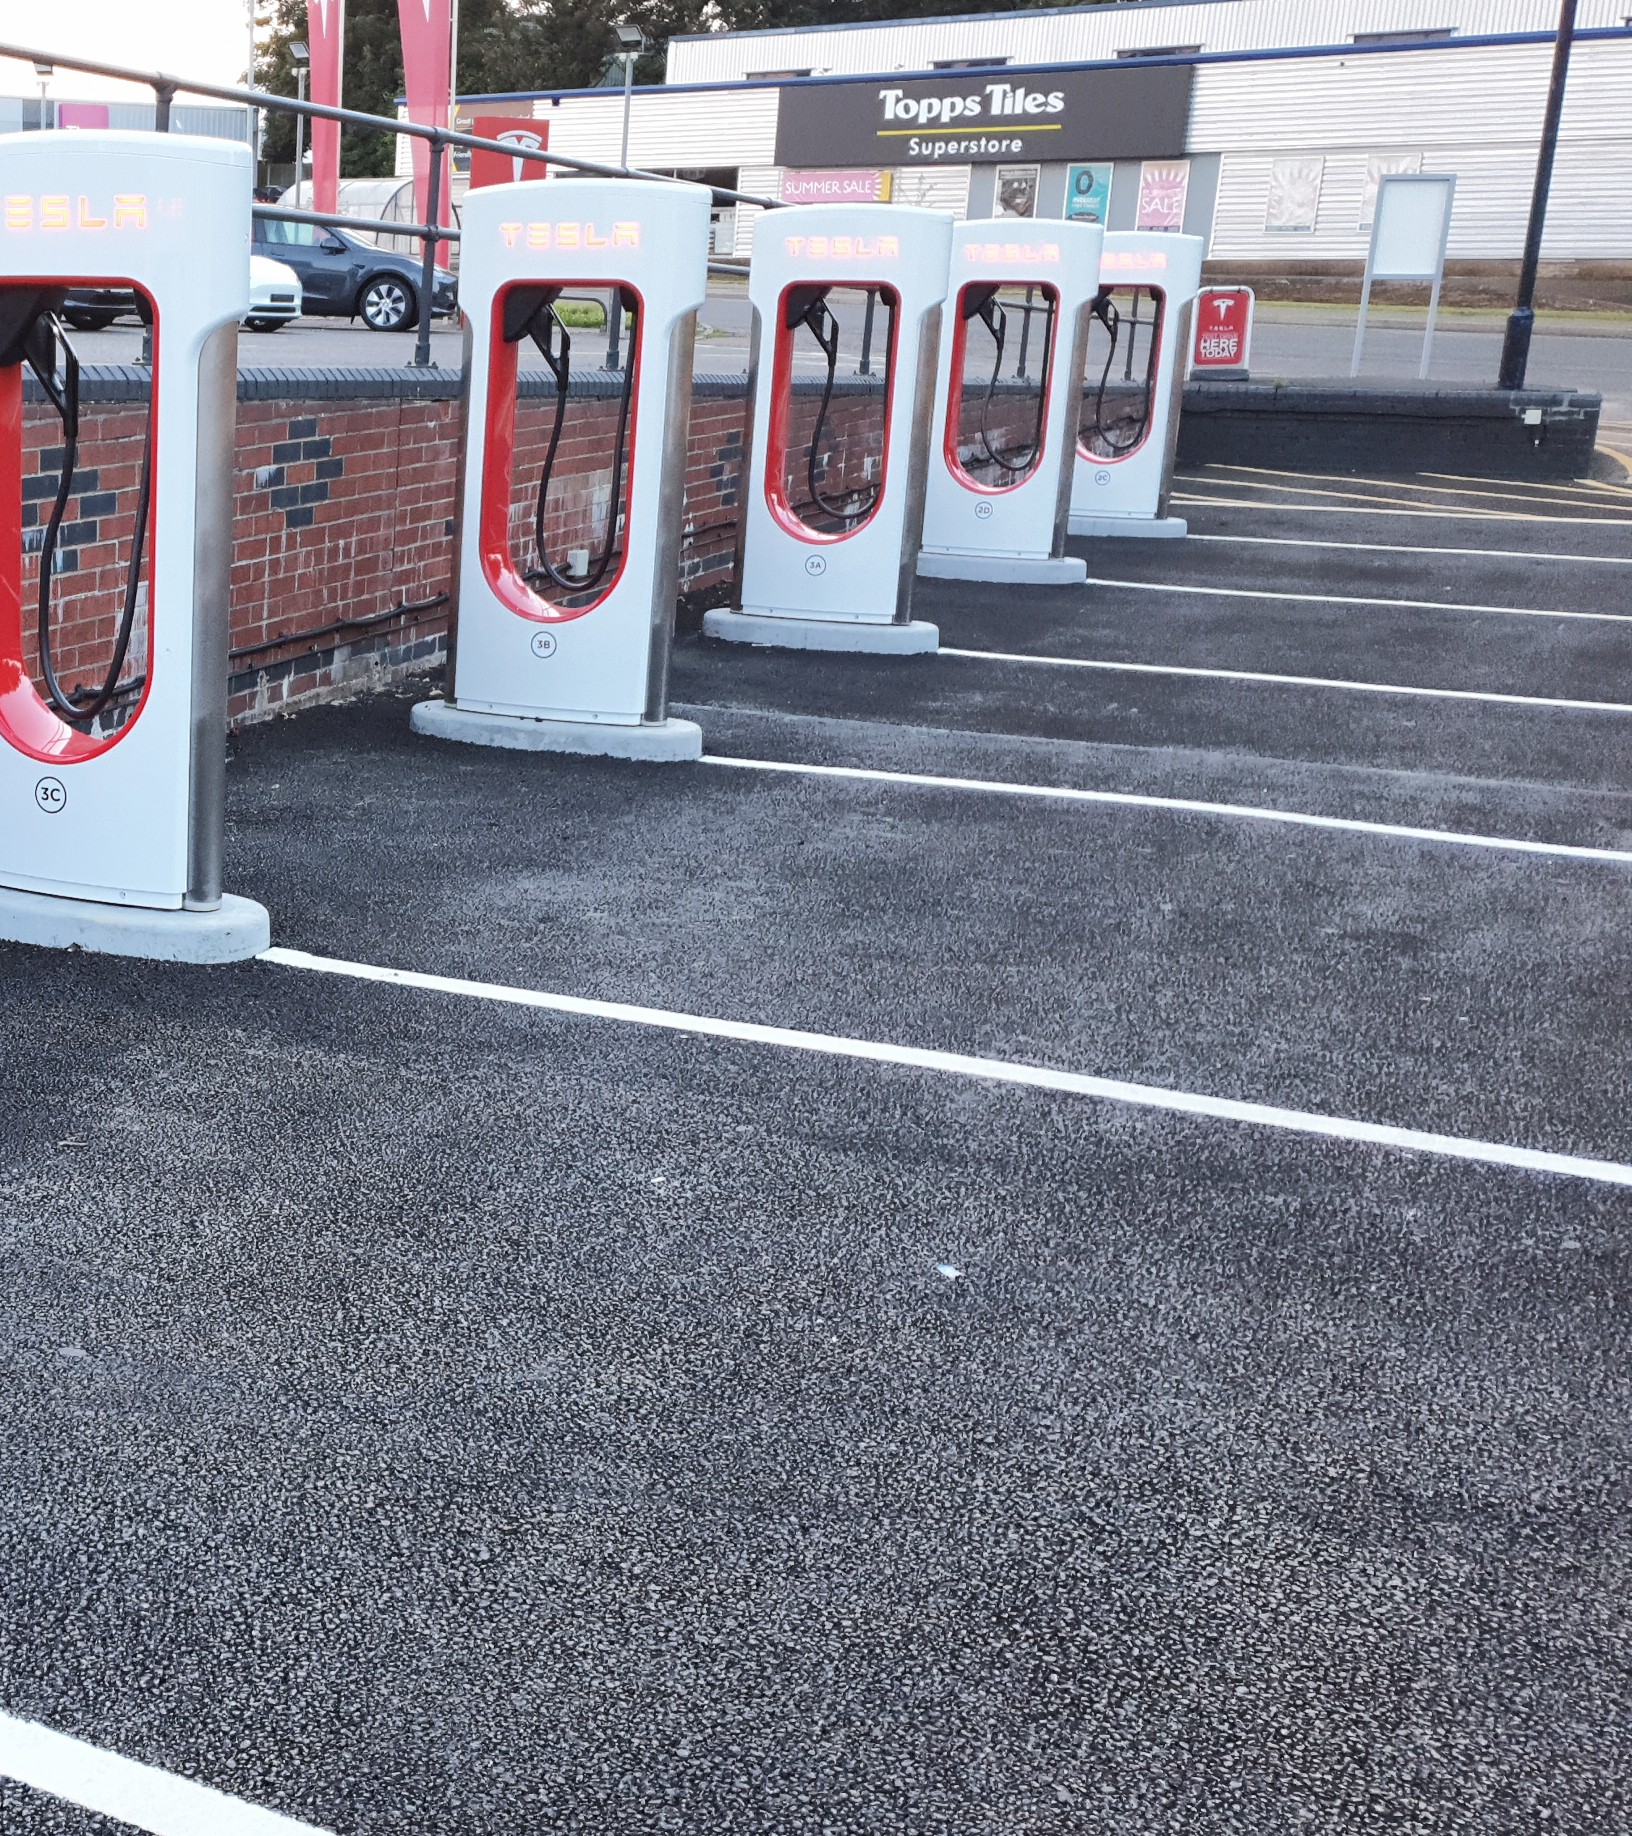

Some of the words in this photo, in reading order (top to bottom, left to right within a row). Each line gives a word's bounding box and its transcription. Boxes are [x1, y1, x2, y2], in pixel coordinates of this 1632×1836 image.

[878, 89, 982, 124] Topps
[984, 83, 1066, 116] Tiles
[909, 136, 1024, 159] Superstore
[785, 181, 842, 195] SUMMER
[843, 180, 873, 194] SALE
[500, 222, 641, 248] TESLA
[785, 235, 900, 257] TESLA
[965, 243, 1060, 262] TESLA
[1102, 252, 1167, 269] ESLA
[1200, 338, 1239, 351] HERE
[1200, 349, 1238, 358] TODAY
[810, 561, 821, 569] 3A
[537, 639, 551, 649] 3B
[41, 786, 61, 802] 3C
